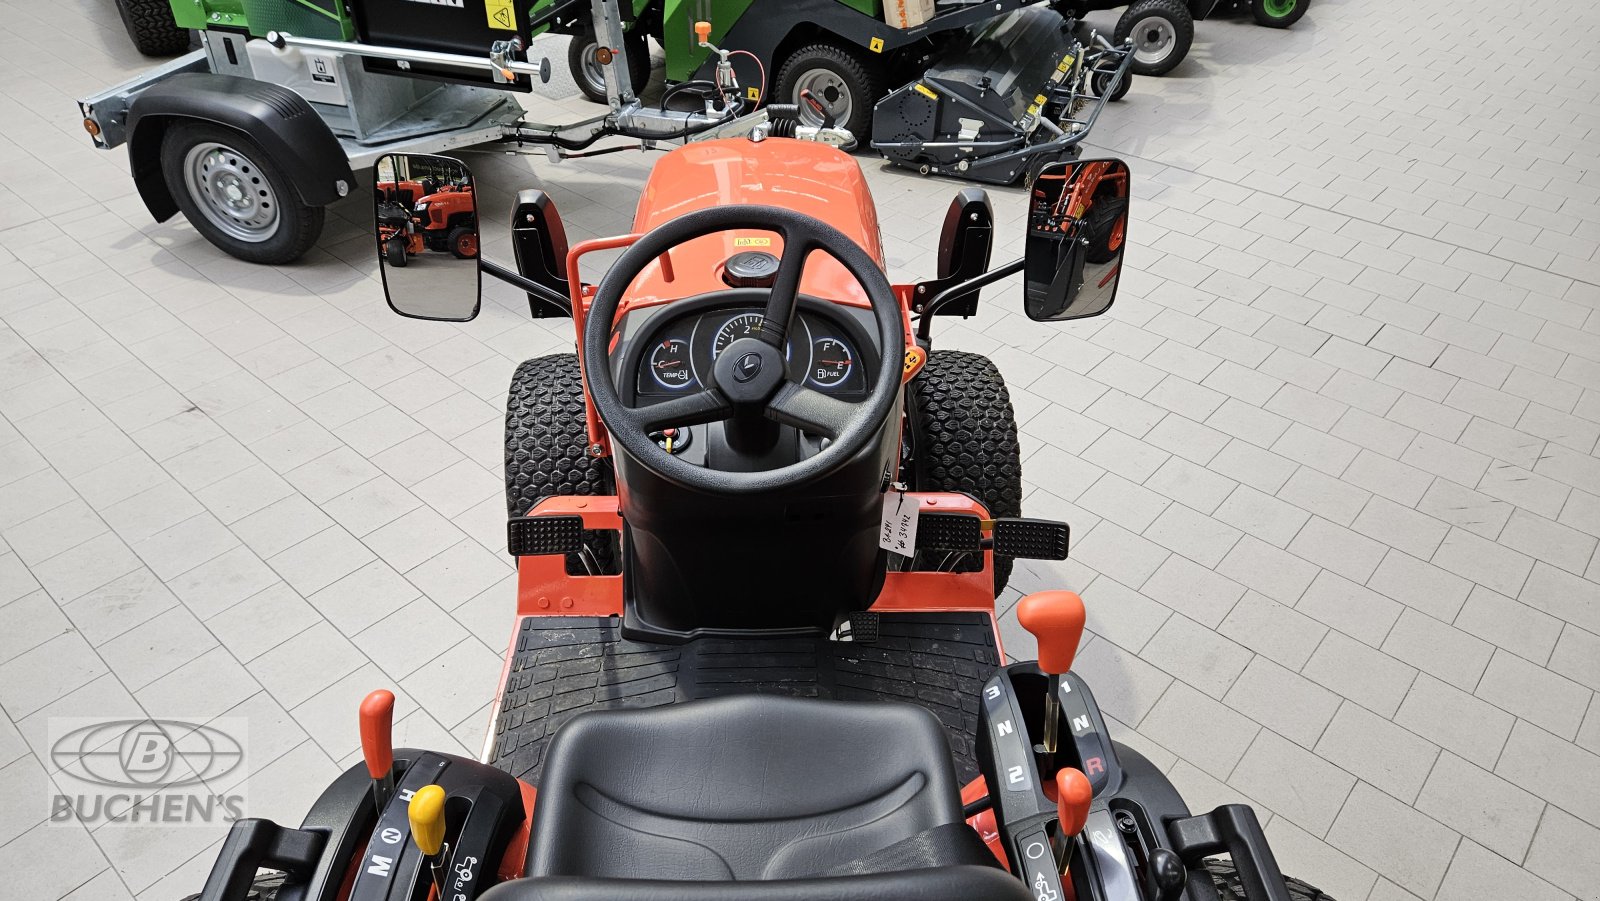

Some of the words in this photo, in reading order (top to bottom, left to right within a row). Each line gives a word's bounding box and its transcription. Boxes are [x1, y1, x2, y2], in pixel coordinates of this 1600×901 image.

[743, 325, 751, 334] 2
[729, 334, 735, 343] 1
[670, 345, 678, 353] H
[823, 343, 831, 351] F
[837, 361, 844, 370] E
[985, 685, 1001, 700] 3
[1061, 681, 1072, 694] 1
[997, 720, 1013, 737] N
[1073, 714, 1090, 732] N
[1086, 757, 1104, 775] R
[1008, 765, 1025, 784] 2
[399, 788, 416, 802] H
[383, 830, 399, 842] N
[367, 855, 393, 877] M
